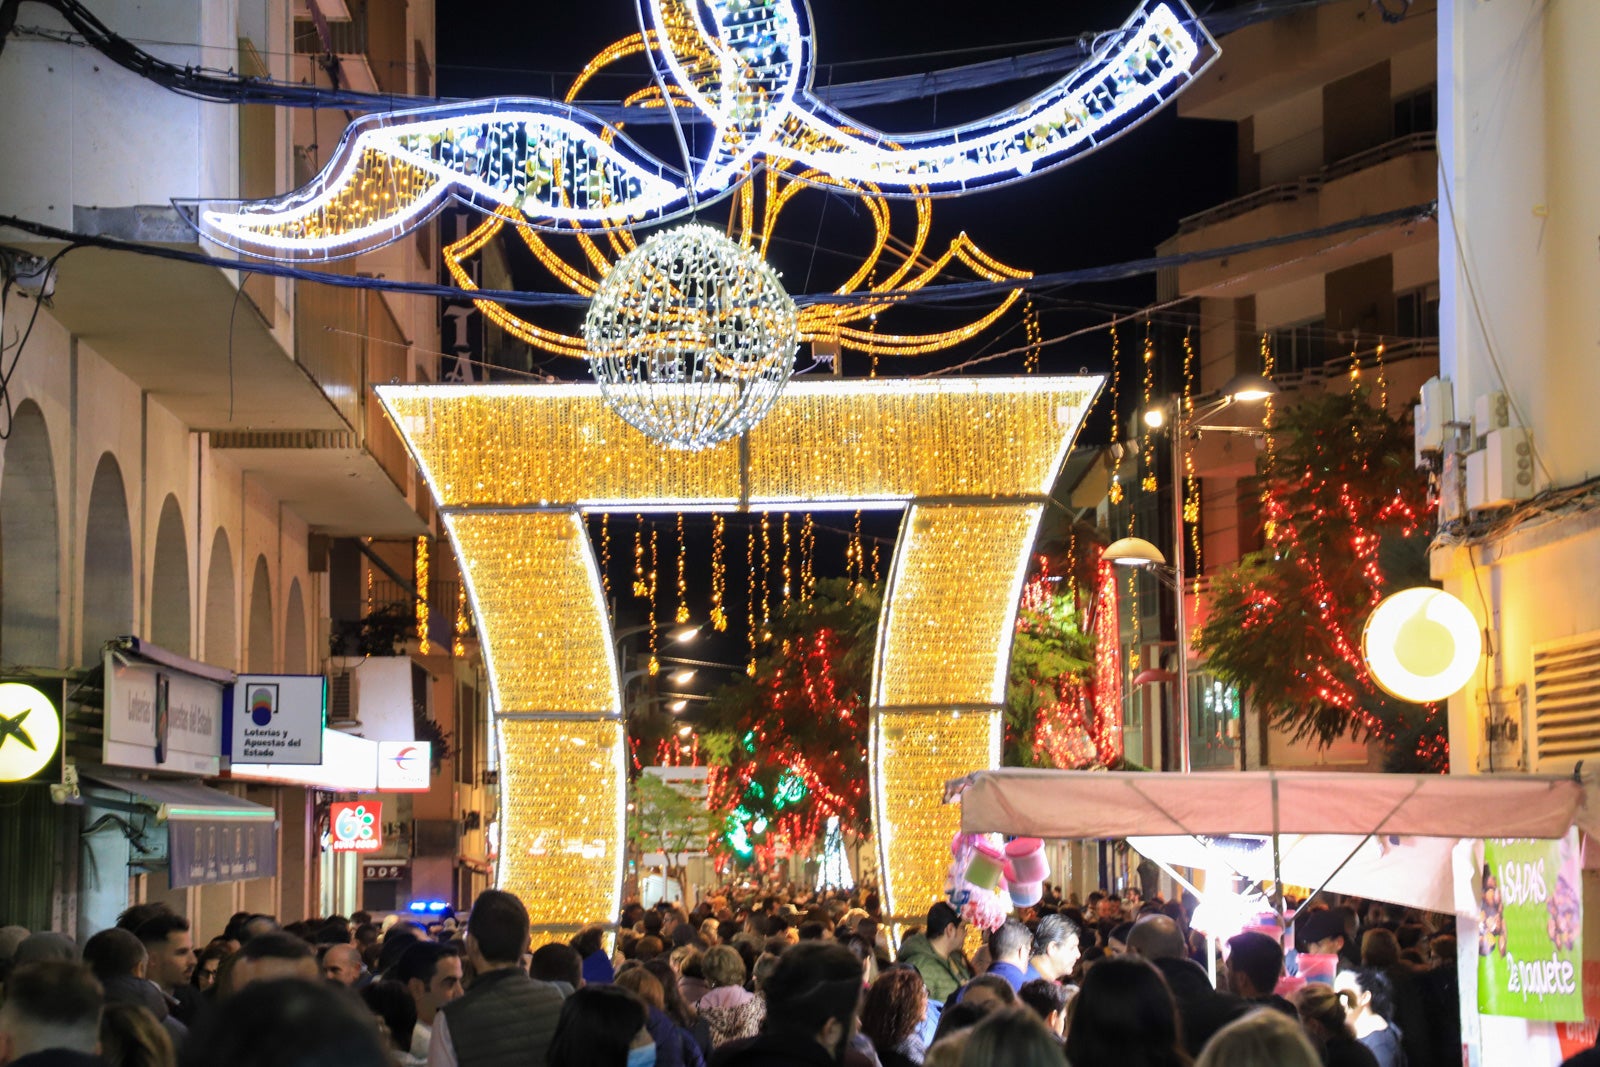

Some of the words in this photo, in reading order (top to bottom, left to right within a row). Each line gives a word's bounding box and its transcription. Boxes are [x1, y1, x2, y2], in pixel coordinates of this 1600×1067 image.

[244, 738, 286, 748] Apuestas
[287, 738, 302, 747] del
[243, 748, 275, 757] Estado
